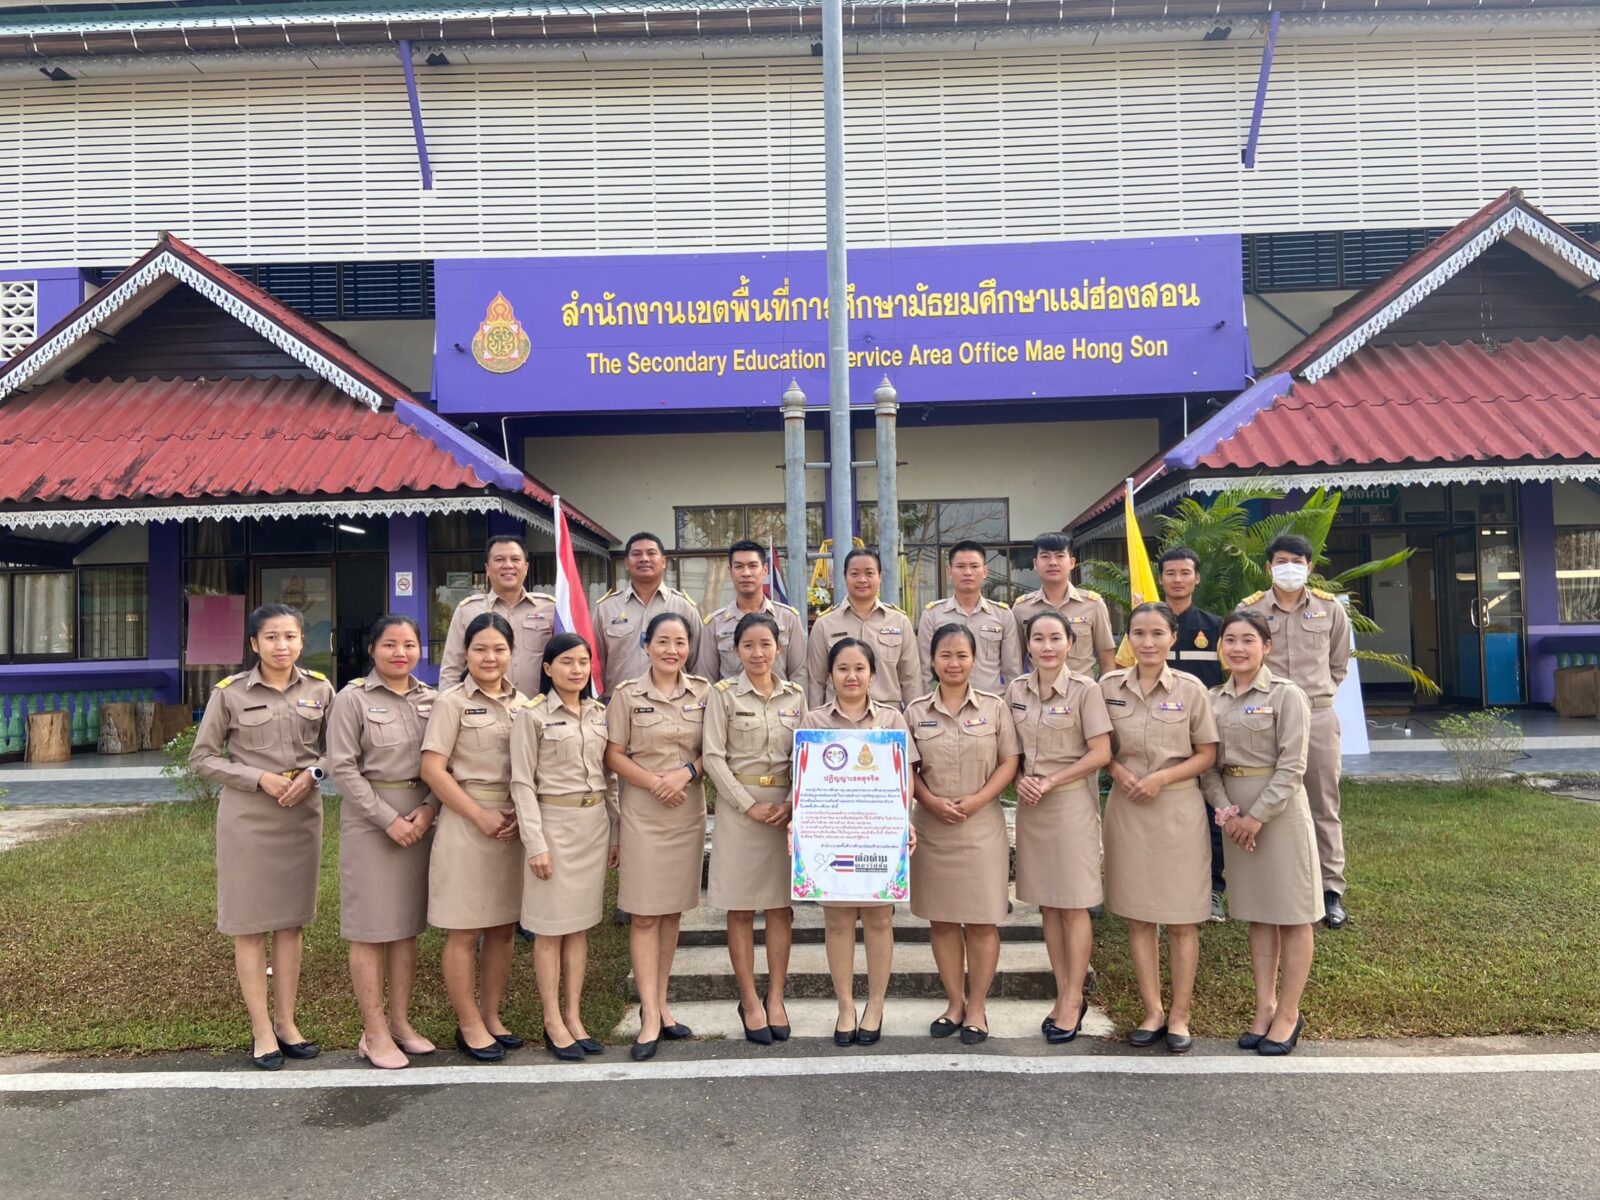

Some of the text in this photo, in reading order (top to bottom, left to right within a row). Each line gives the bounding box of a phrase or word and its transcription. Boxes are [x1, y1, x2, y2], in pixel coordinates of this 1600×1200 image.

[587, 334, 1169, 377] The Secondary Education ervice Area Office Mae Hong Son
